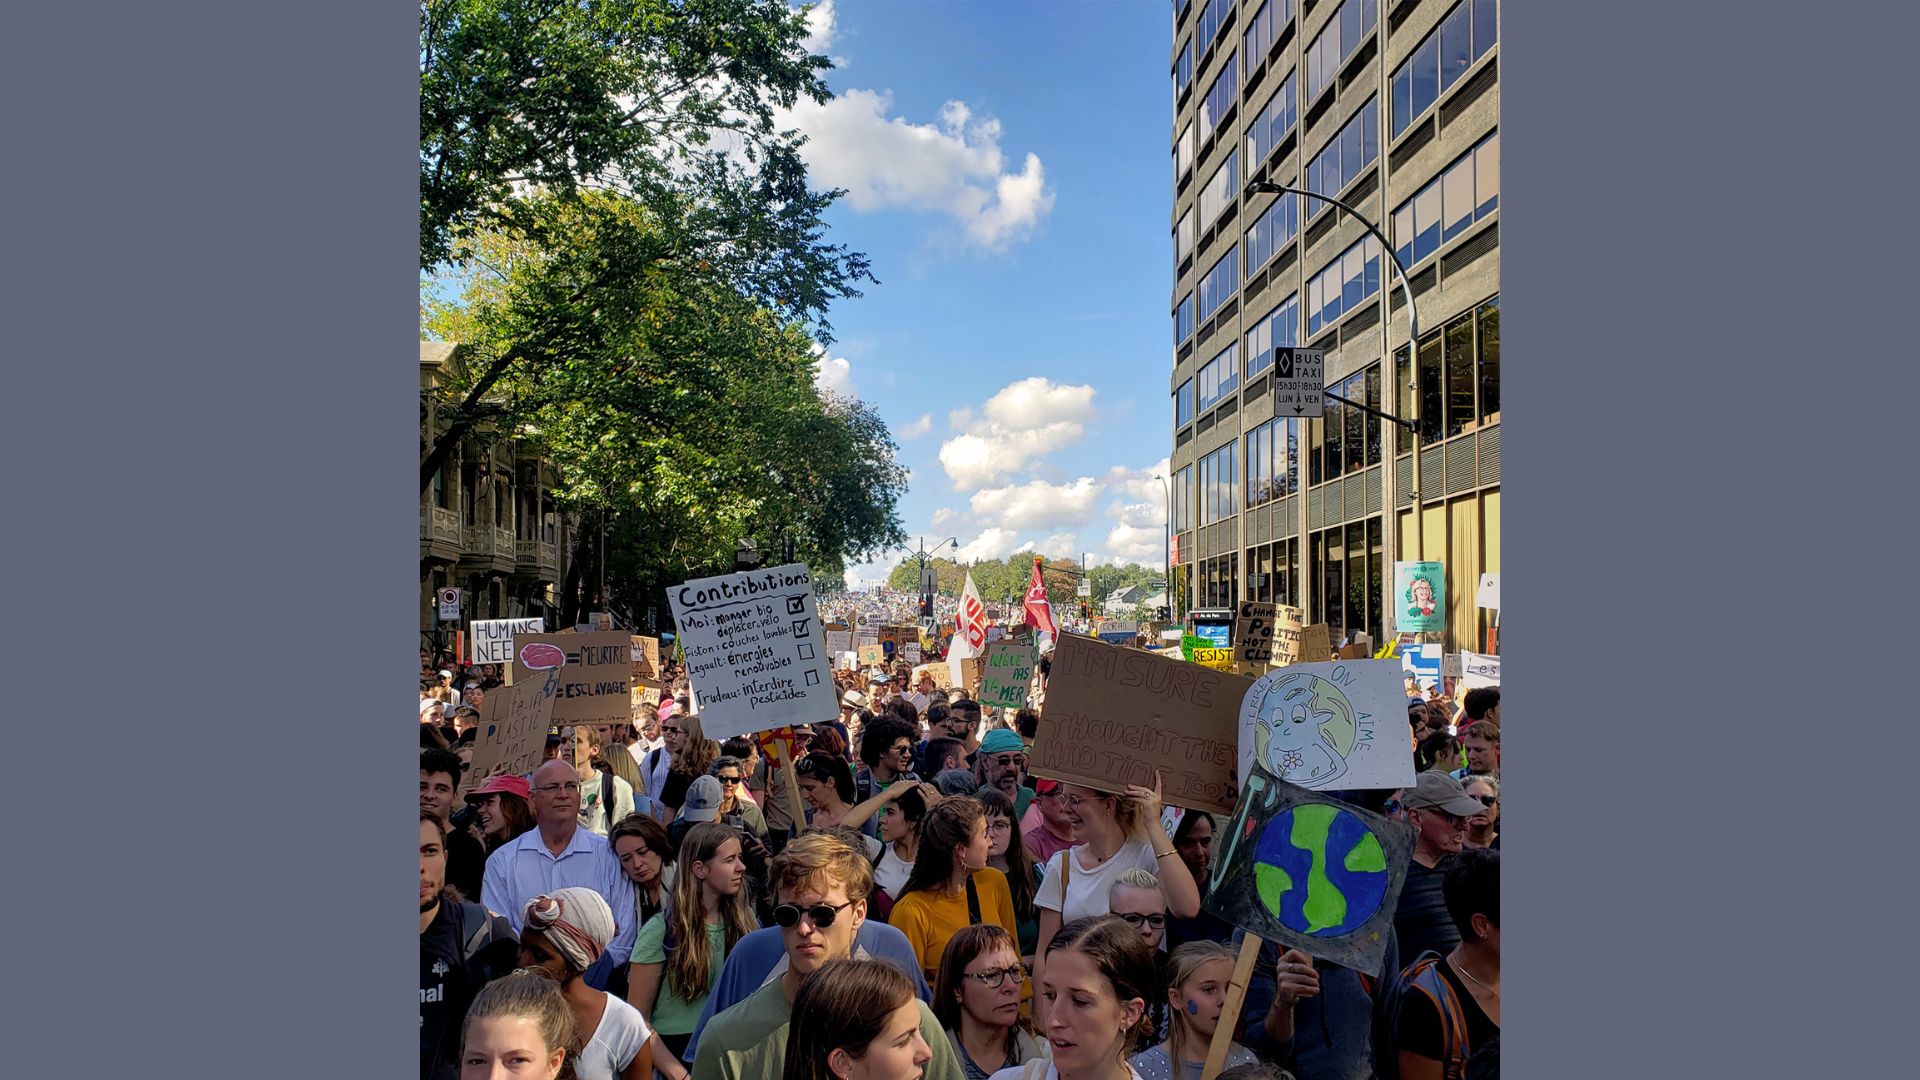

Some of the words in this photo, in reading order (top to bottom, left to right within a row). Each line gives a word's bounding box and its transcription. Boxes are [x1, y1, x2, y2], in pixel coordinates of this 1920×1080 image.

[1295, 354, 1321, 364] BUS
[1295, 367, 1321, 378] TAXI
[1278, 394, 1293, 404] LUN
[1304, 395, 1320, 404] VEN
[679, 572, 809, 607] Contributions
[715, 608, 752, 626] manger
[756, 604, 773, 616] bio
[476, 619, 539, 640] HUMANS
[721, 633, 760, 650] couches
[727, 645, 774, 666] énergies
[1193, 650, 1233, 662] RESIST
[734, 656, 792, 678] renouvables
[1013, 667, 1030, 681] PAS
[1062, 641, 1118, 680] I'M
[1120, 655, 1221, 708] SURE
[1331, 665, 1356, 687] ON
[695, 687, 742, 706] Trudeau:
[742, 678, 795, 697] interdire
[750, 689, 807, 709] pesticides
[999, 685, 1024, 704] MER
[1044, 712, 1180, 755] THOUGHT
[1353, 711, 1375, 752] AIME
